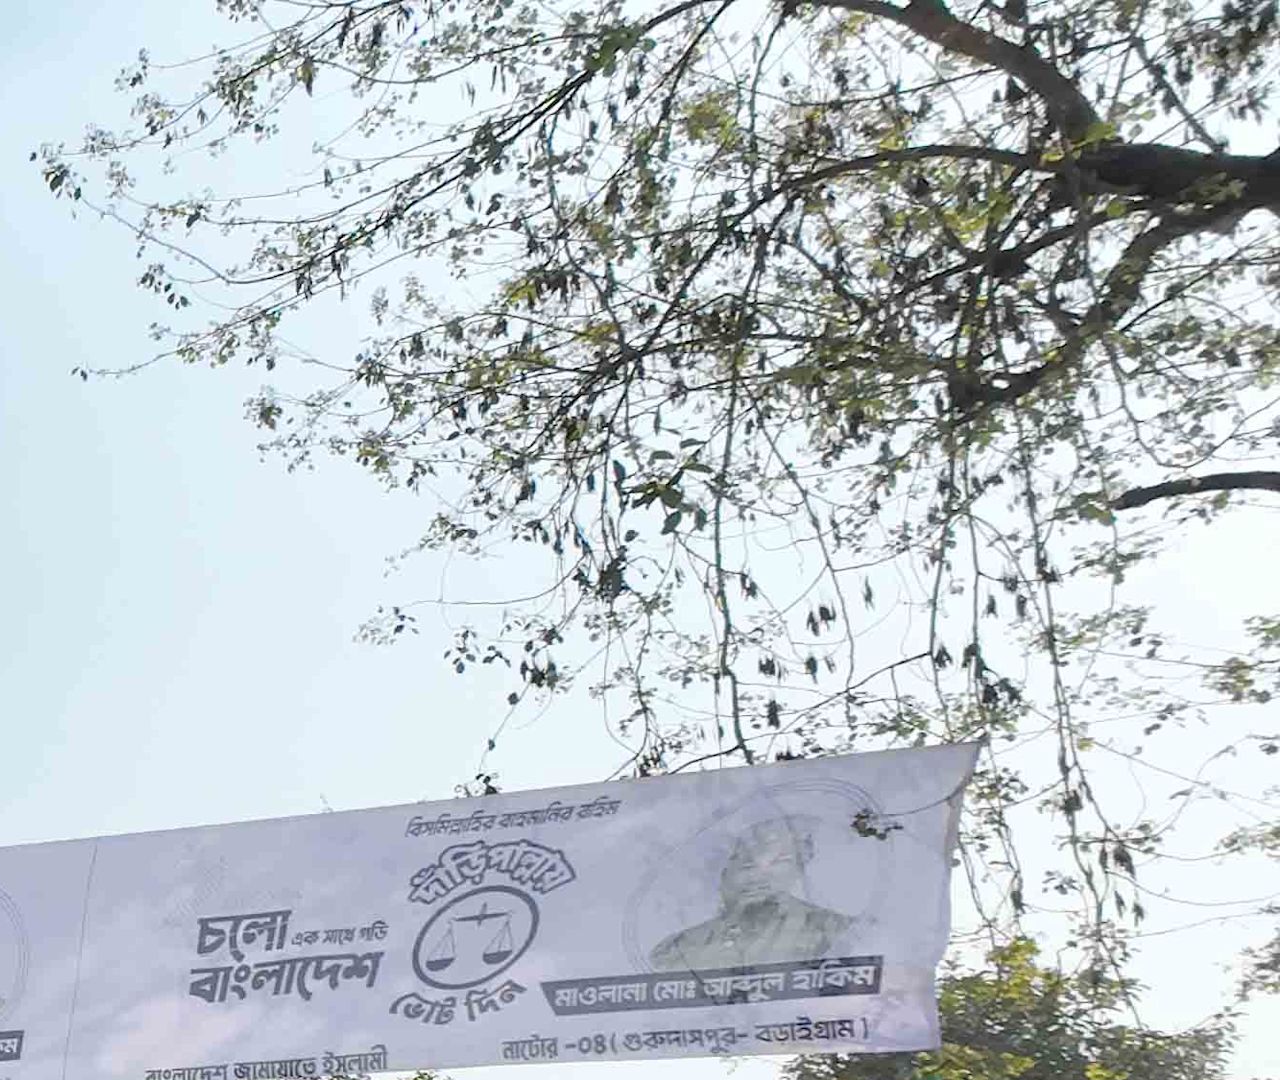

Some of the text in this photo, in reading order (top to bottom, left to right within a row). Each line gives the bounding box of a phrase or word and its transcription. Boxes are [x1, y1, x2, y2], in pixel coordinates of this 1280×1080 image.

[408, 838, 577, 905] দাঁড়িপাল্লায়
[197, 909, 292, 963] চলো
[189, 951, 385, 1003] বাংলাদেশ
[389, 978, 527, 1026] ভোট দিন
[554, 981, 647, 1009] মাওলানা
[702, 970, 786, 1002] আব্দুল
[792, 958, 874, 992] হাকিম
[322, 1043, 389, 1075] ইসলামী
[501, 1033, 559, 1060] নাটোর
